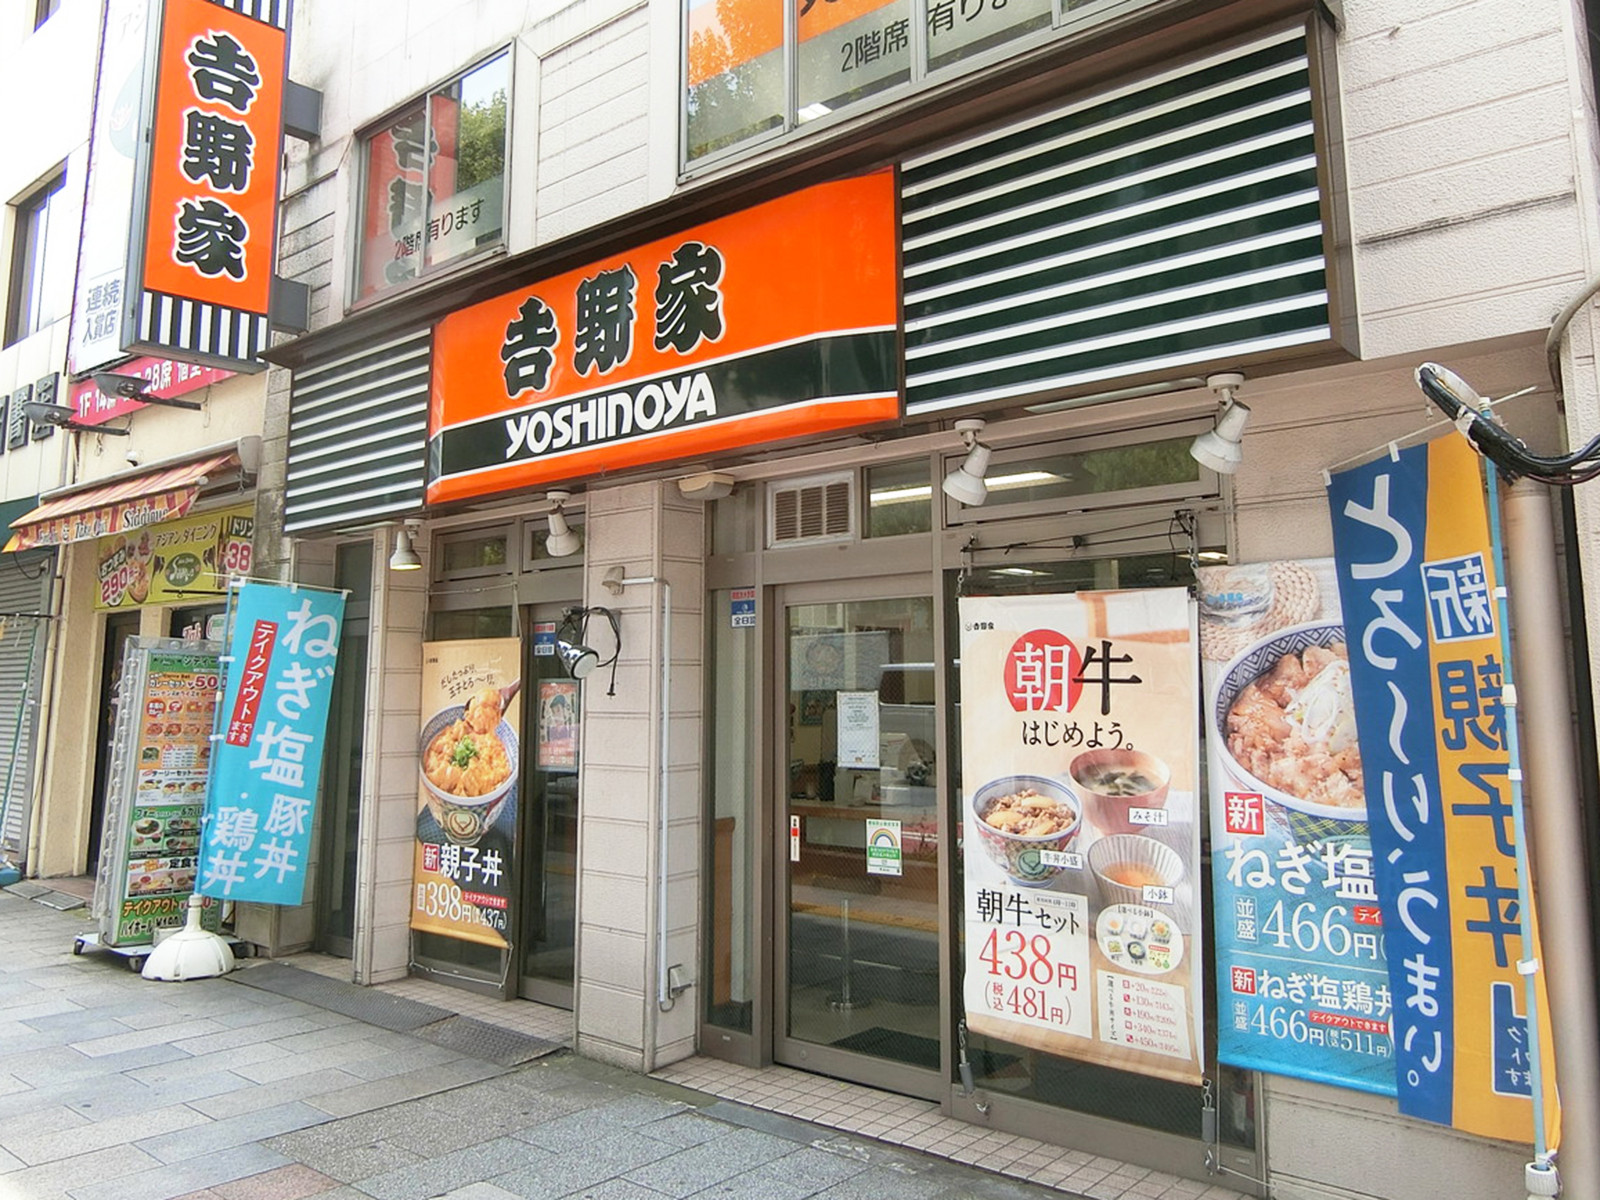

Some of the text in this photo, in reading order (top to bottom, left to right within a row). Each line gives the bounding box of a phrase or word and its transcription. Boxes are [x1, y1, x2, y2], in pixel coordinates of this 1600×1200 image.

[174, 29, 262, 281] 吉野家
[501, 241, 725, 398] 吉野家
[1013, 639, 1143, 716] 朝牛
[1022, 720, 1134, 751] はじめよう。
[1132, 810, 1164, 823] みそ汁
[1227, 796, 1259, 831] 新
[440, 842, 503, 886] 親子丼
[1225, 839, 1378, 901] ねぎ塩
[977, 888, 1080, 936] 朝牛セット
[979, 927, 1078, 991] 438円
[1234, 969, 1256, 992] 新
